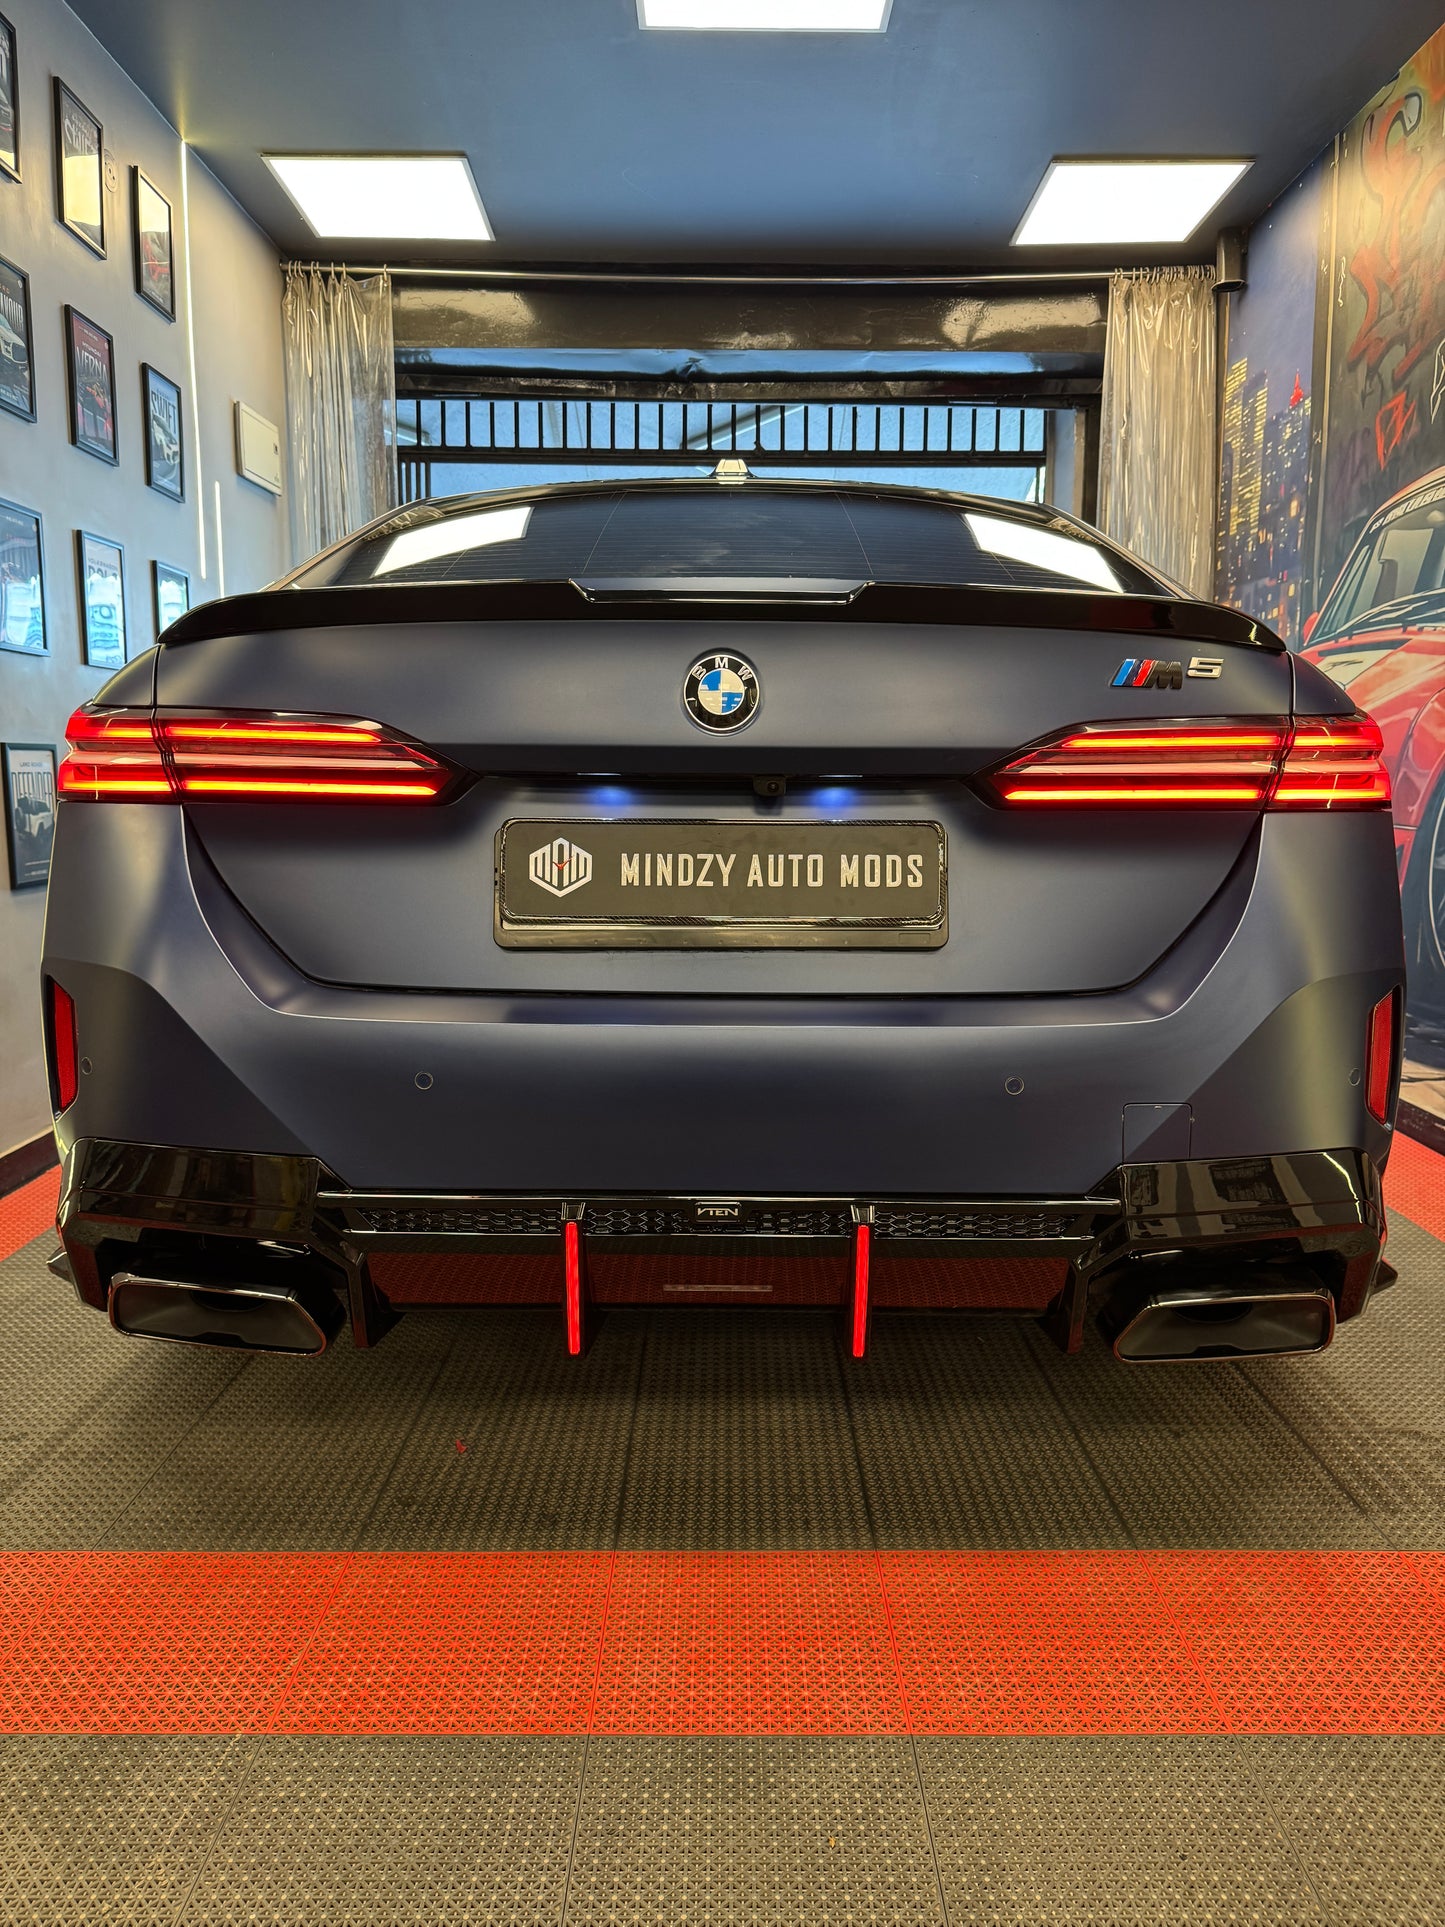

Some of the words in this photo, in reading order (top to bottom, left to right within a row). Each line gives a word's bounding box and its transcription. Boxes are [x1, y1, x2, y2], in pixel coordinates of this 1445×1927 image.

[151, 390, 176, 434] SWIFT
[692, 656, 753, 681] BMW
[620, 853, 737, 887] MINDZY
[746, 853, 824, 888] AUTO
[840, 854, 924, 888] MODS
